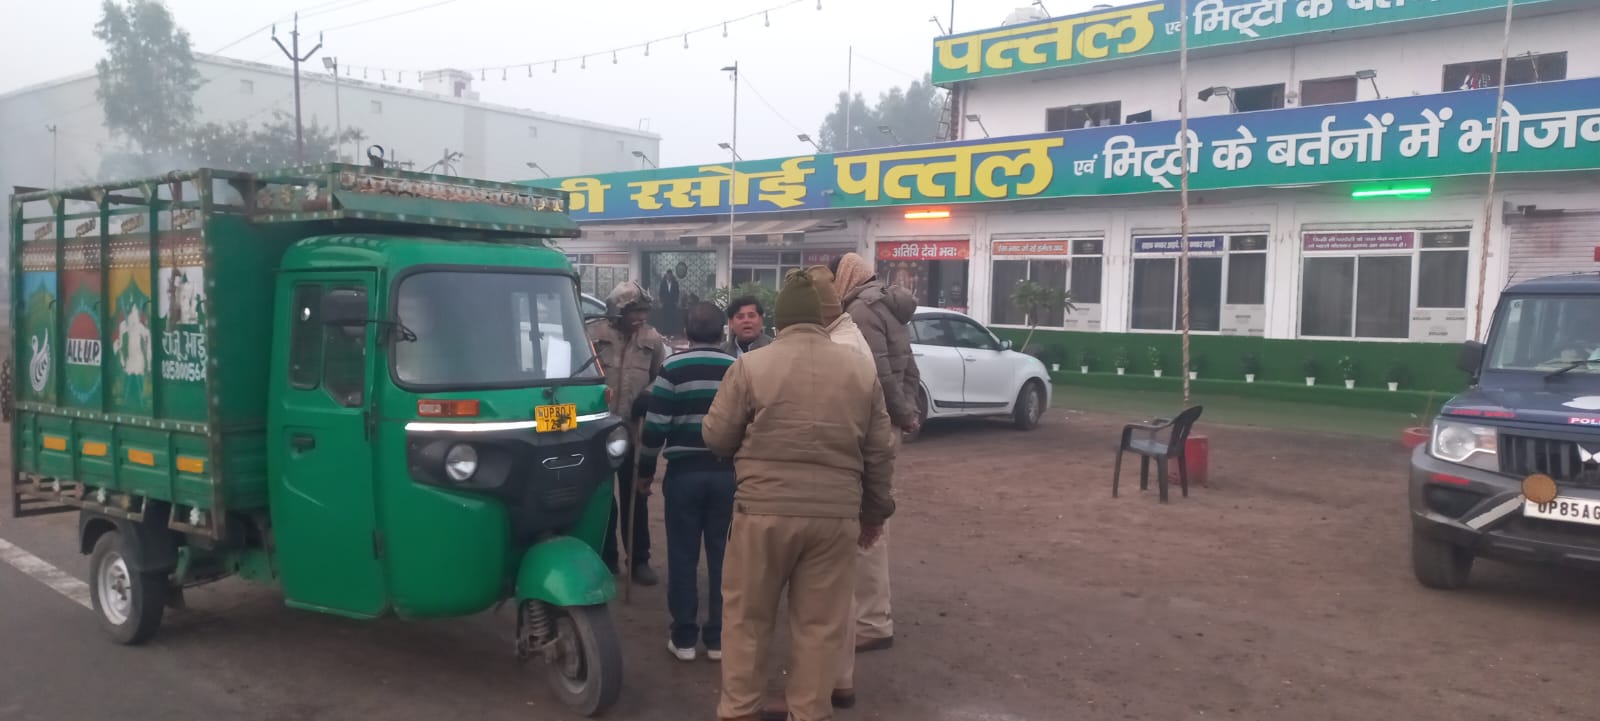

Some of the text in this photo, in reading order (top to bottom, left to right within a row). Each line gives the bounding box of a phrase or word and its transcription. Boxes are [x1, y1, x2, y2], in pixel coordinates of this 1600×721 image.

[935, 4, 1164, 74] पत्तल
[627, 156, 816, 210] रसोई
[833, 137, 1064, 200] पत्तल
[1073, 154, 1098, 176] एवं
[1103, 129, 1203, 188] मिट्टी
[1211, 125, 1257, 170] के
[1266, 112, 1394, 166] बर्तनों
[1399, 107, 1453, 157] में
